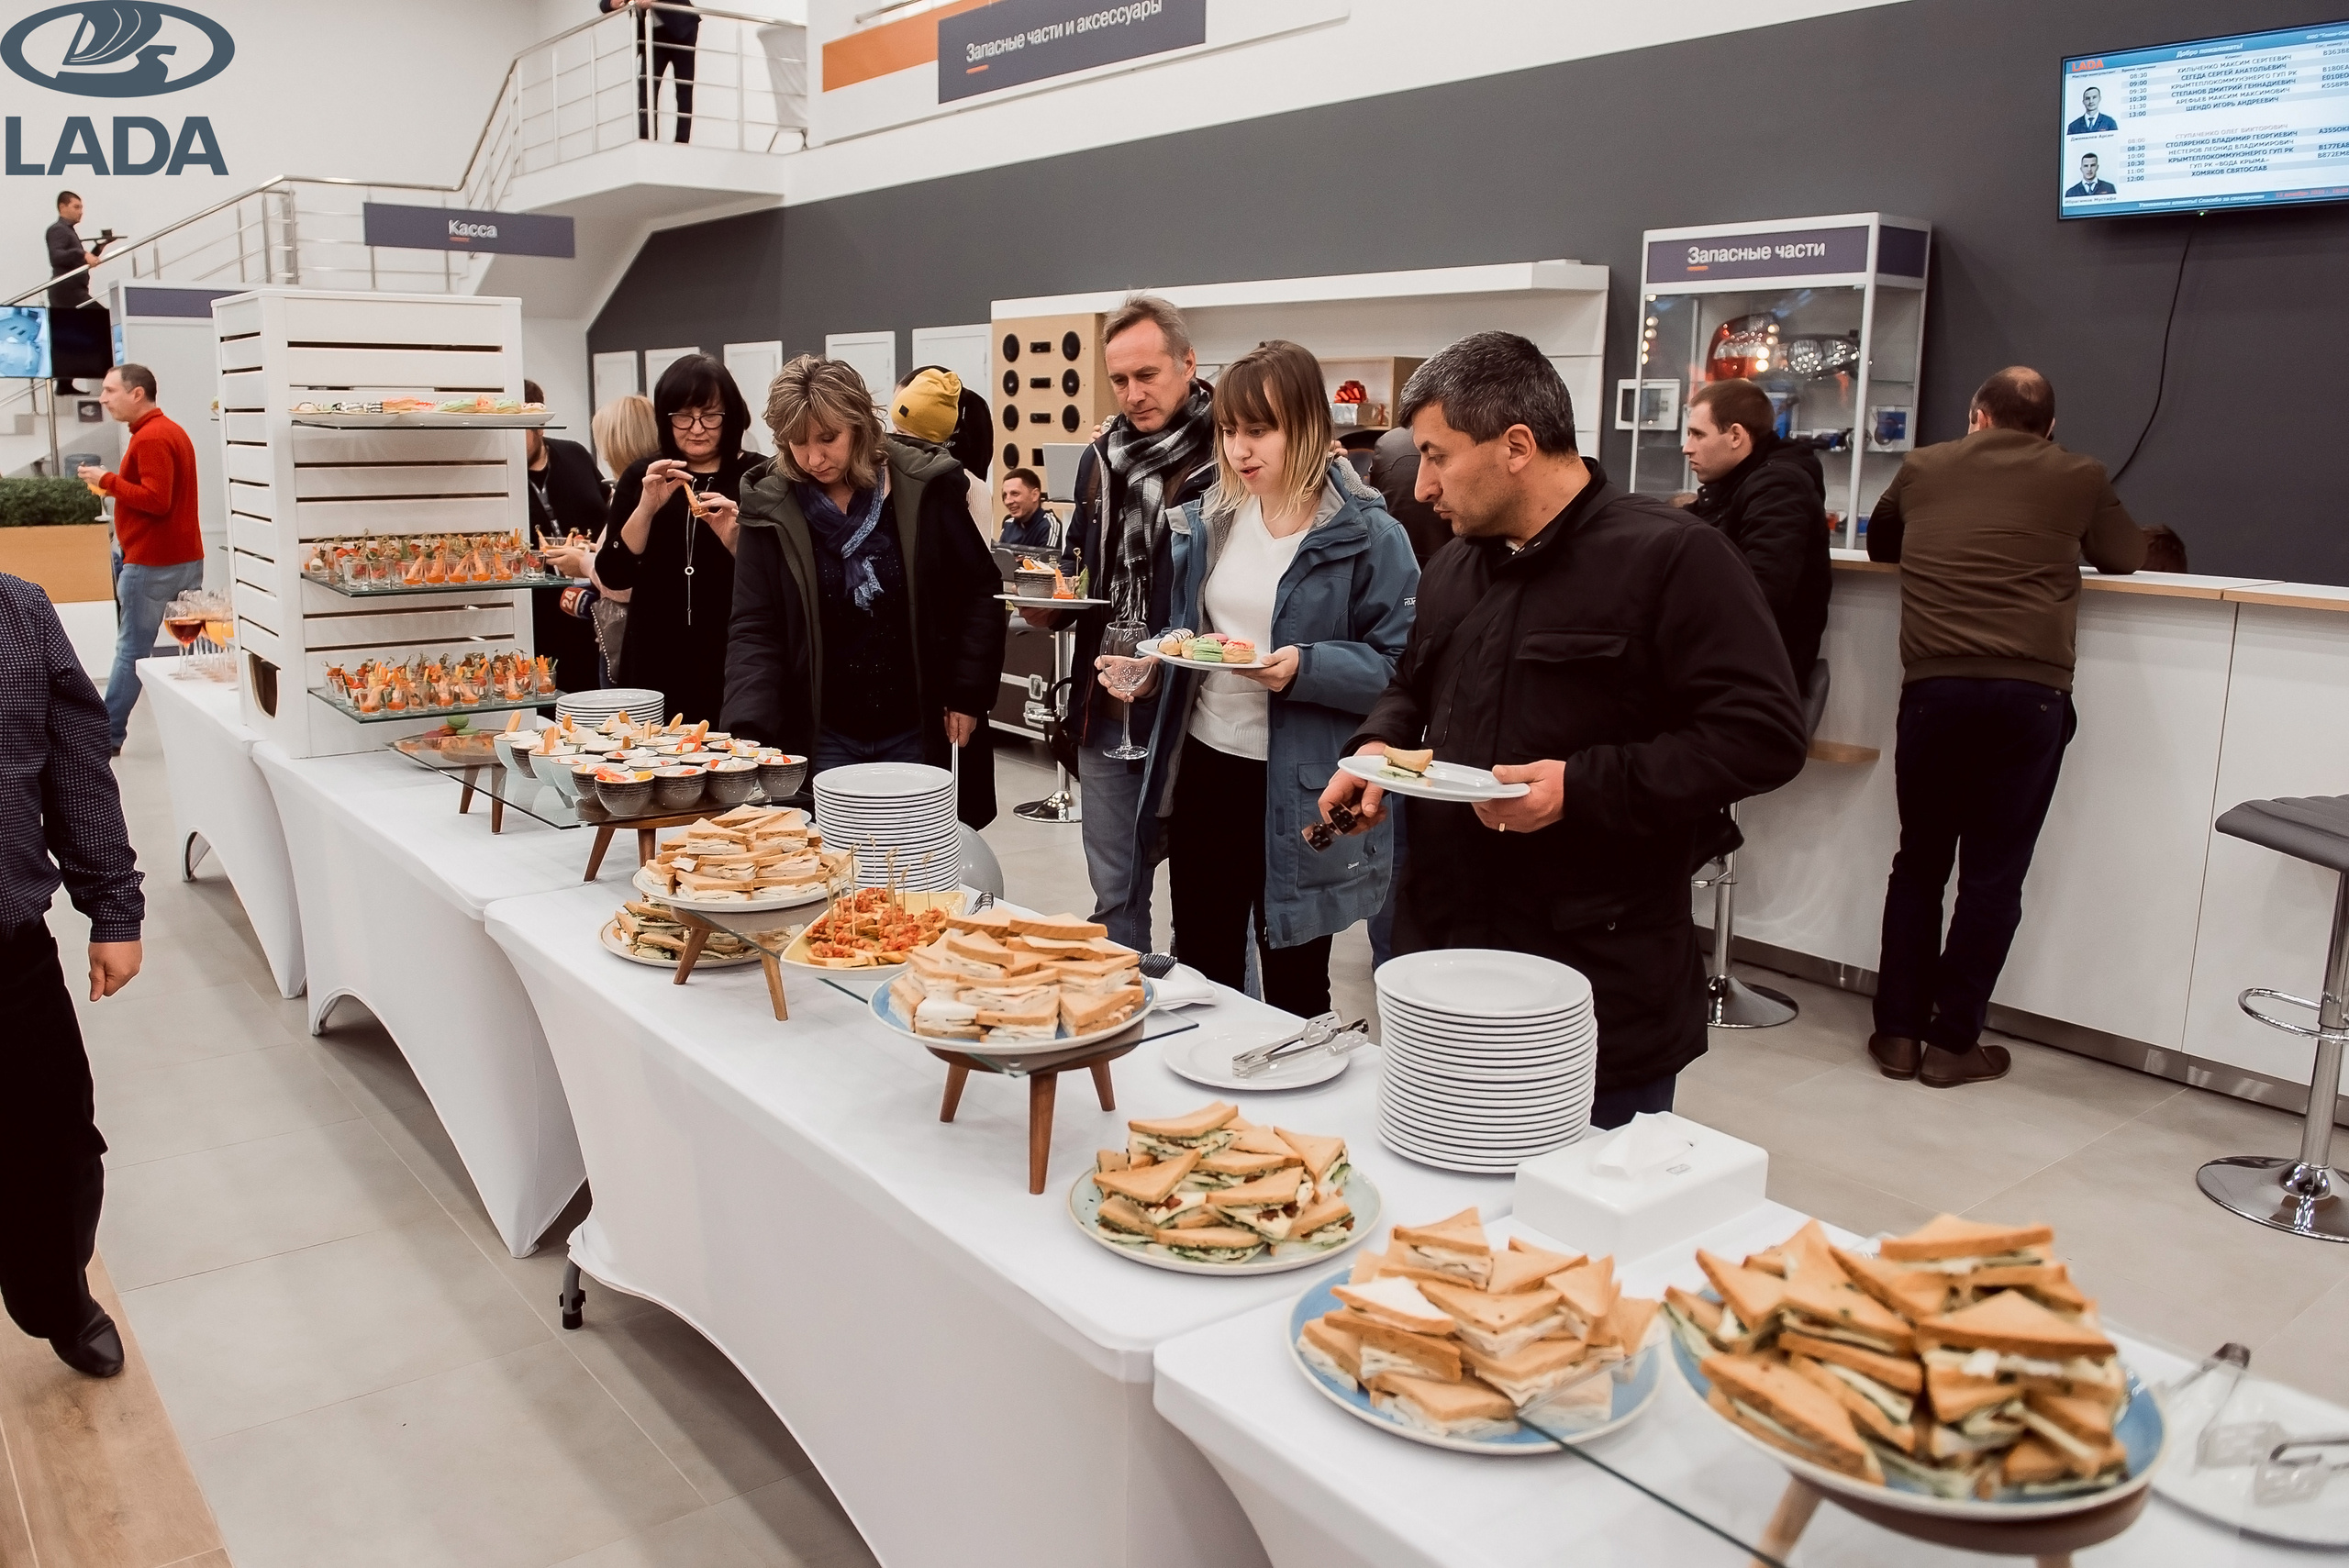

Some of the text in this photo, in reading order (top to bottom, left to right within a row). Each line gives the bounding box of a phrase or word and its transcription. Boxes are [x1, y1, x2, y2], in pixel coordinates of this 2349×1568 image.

[966, 0, 1163, 63] Запасные части и аксессуары
[2176, 49, 2199, 59] Добро
[2072, 59, 2104, 72] LADA
[2176, 55, 2292, 73] ХИЛЬЧЕНКО МАКСИМ СЕРГЕЕВИЧ
[2208, 68, 2233, 77] СЕРГЕЙ
[2234, 63, 2287, 74] АНАТОЛЬЕВИЧ
[2171, 79, 2297, 98] СТЕПАНОВ ДМИТРИЙ ГЕННАДИЕВИЧ
[2176, 87, 2291, 105] АРЕФЬЕВ МАКСИМ МАКСИМОВИЧ
[2186, 96, 2279, 111] ШЕНДО ИГОРЬ АНДРЕЕВИЧ
[2165, 131, 2298, 149] СТОЛЯРЕНКО ВЛАДИМИР ГЕОРГИЕВИЧ
[2175, 130, 2220, 139] СТУПАЧЕНКО
[2240, 124, 2288, 134] ВИКТОРОВИЧ
[2168, 139, 2294, 155] НЕСТЕРОВ ЛЕОНИД ВЛАДИМИРОВИЧ
[2191, 164, 2268, 177] ХОМЯКОВ СВЯТОСЛАВ
[448, 219, 498, 239] Касса
[1687, 241, 1825, 265] Запасные части
